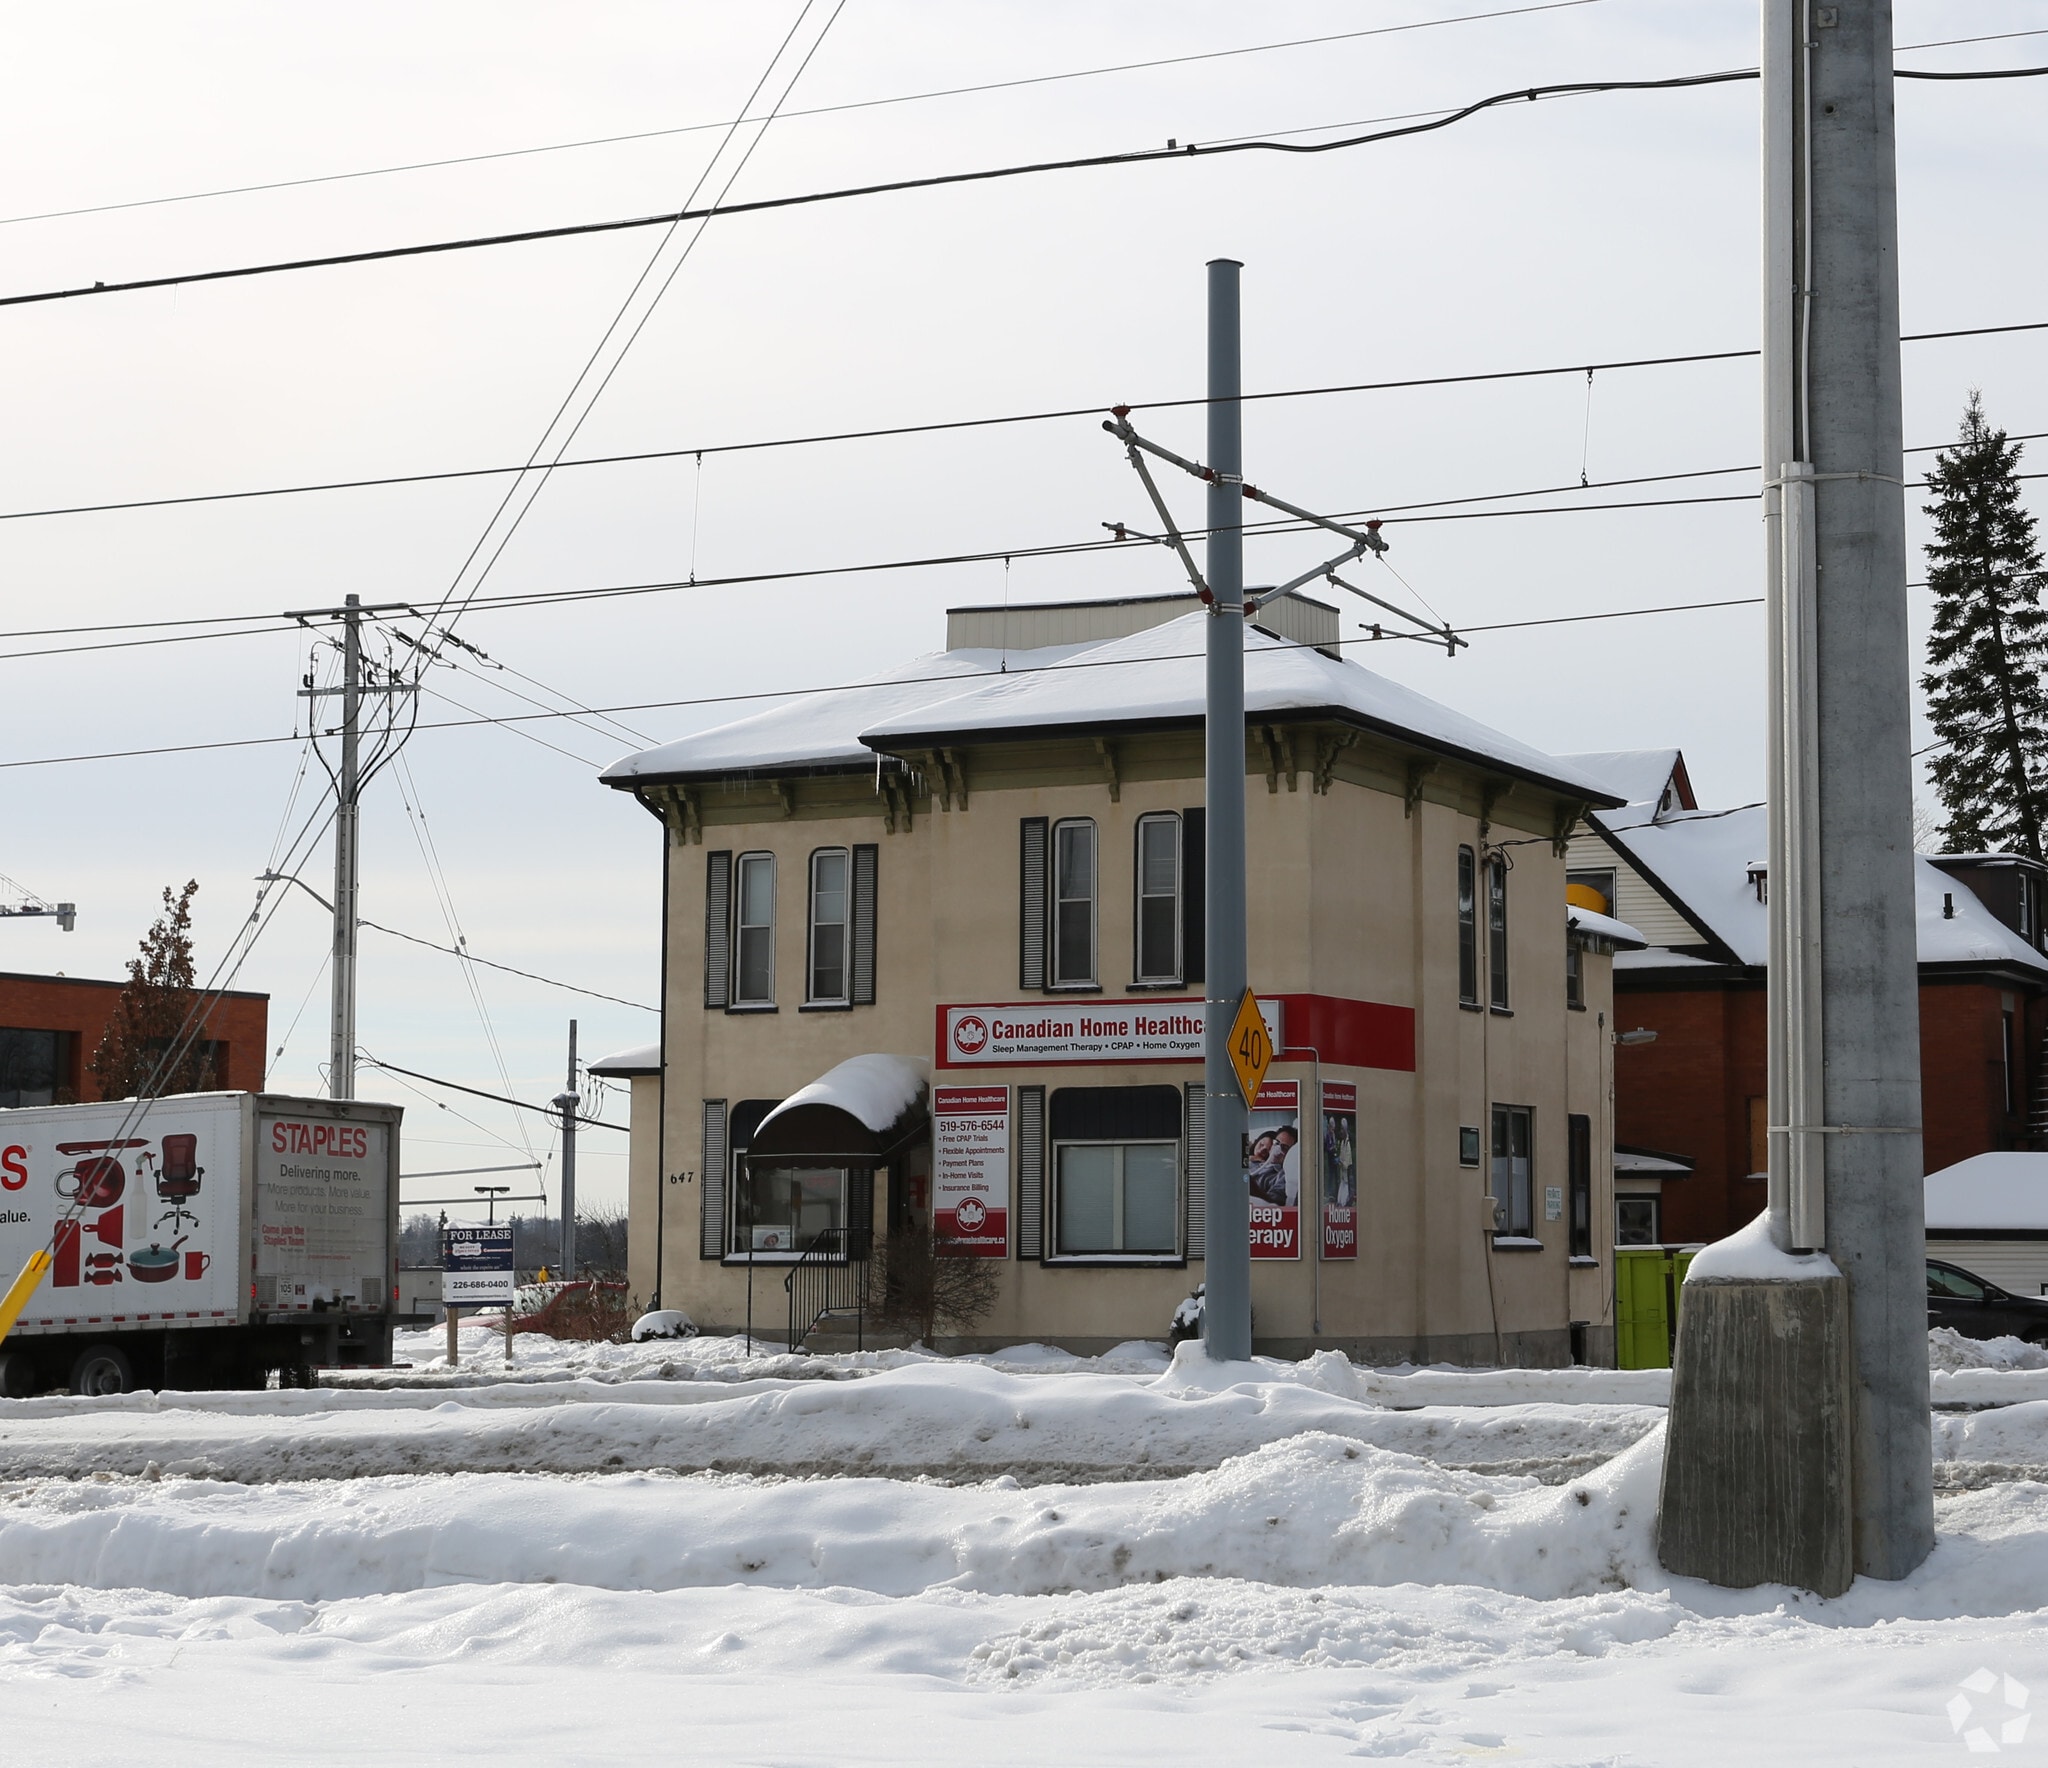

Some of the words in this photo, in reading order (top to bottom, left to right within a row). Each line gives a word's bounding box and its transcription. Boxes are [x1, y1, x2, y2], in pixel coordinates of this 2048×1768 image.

[992, 1019, 1074, 1040] Canadian
[1080, 1018, 1128, 1037] Home
[1135, 1016, 1207, 1035] Healthc
[992, 1044, 1015, 1054] Sleep
[1016, 1043, 1069, 1054] Management
[1070, 1042, 1102, 1053] Therapy
[1110, 1042, 1134, 1050] CPAP
[1142, 1041, 1167, 1049] Home
[1169, 1040, 1200, 1051] Oxygen
[1239, 1027, 1262, 1070] 40
[1266, 1090, 1296, 1098] Healthcare
[940, 1120, 1004, 1132] 519-576-6544
[272, 1122, 367, 1158] STAPLES
[973, 1134, 988, 1142] Trials
[965, 1147, 1005, 1155] Appointments
[942, 1160, 967, 1168] Payment
[280, 1164, 330, 1182] Delivering
[333, 1169, 361, 1181] more.
[670, 1171, 694, 1184] 647
[942, 1171, 967, 1179] In-Home
[267, 1183, 288, 1195] More
[290, 1184, 327, 1197] products.
[329, 1186, 348, 1198] More
[350, 1188, 371, 1199] value.
[971, 1184, 989, 1192] Billing
[275, 1200, 295, 1212] More
[297, 1201, 307, 1213] for
[310, 1204, 327, 1215] your
[1329, 1204, 1350, 1223] Home
[1249, 1204, 1282, 1226] leep
[262, 1224, 280, 1234] Come
[281, 1225, 293, 1236] join
[294, 1225, 304, 1235] the
[450, 1230, 473, 1240] FOR
[476, 1230, 511, 1240] LEASE
[264, 1235, 287, 1247] Staples
[288, 1236, 305, 1246] Team
[1249, 1229, 1293, 1248] erapy
[1326, 1226, 1354, 1248] Oxygen
[280, 1284, 292, 1293] 105
[453, 1280, 508, 1289] 226-686-0400
